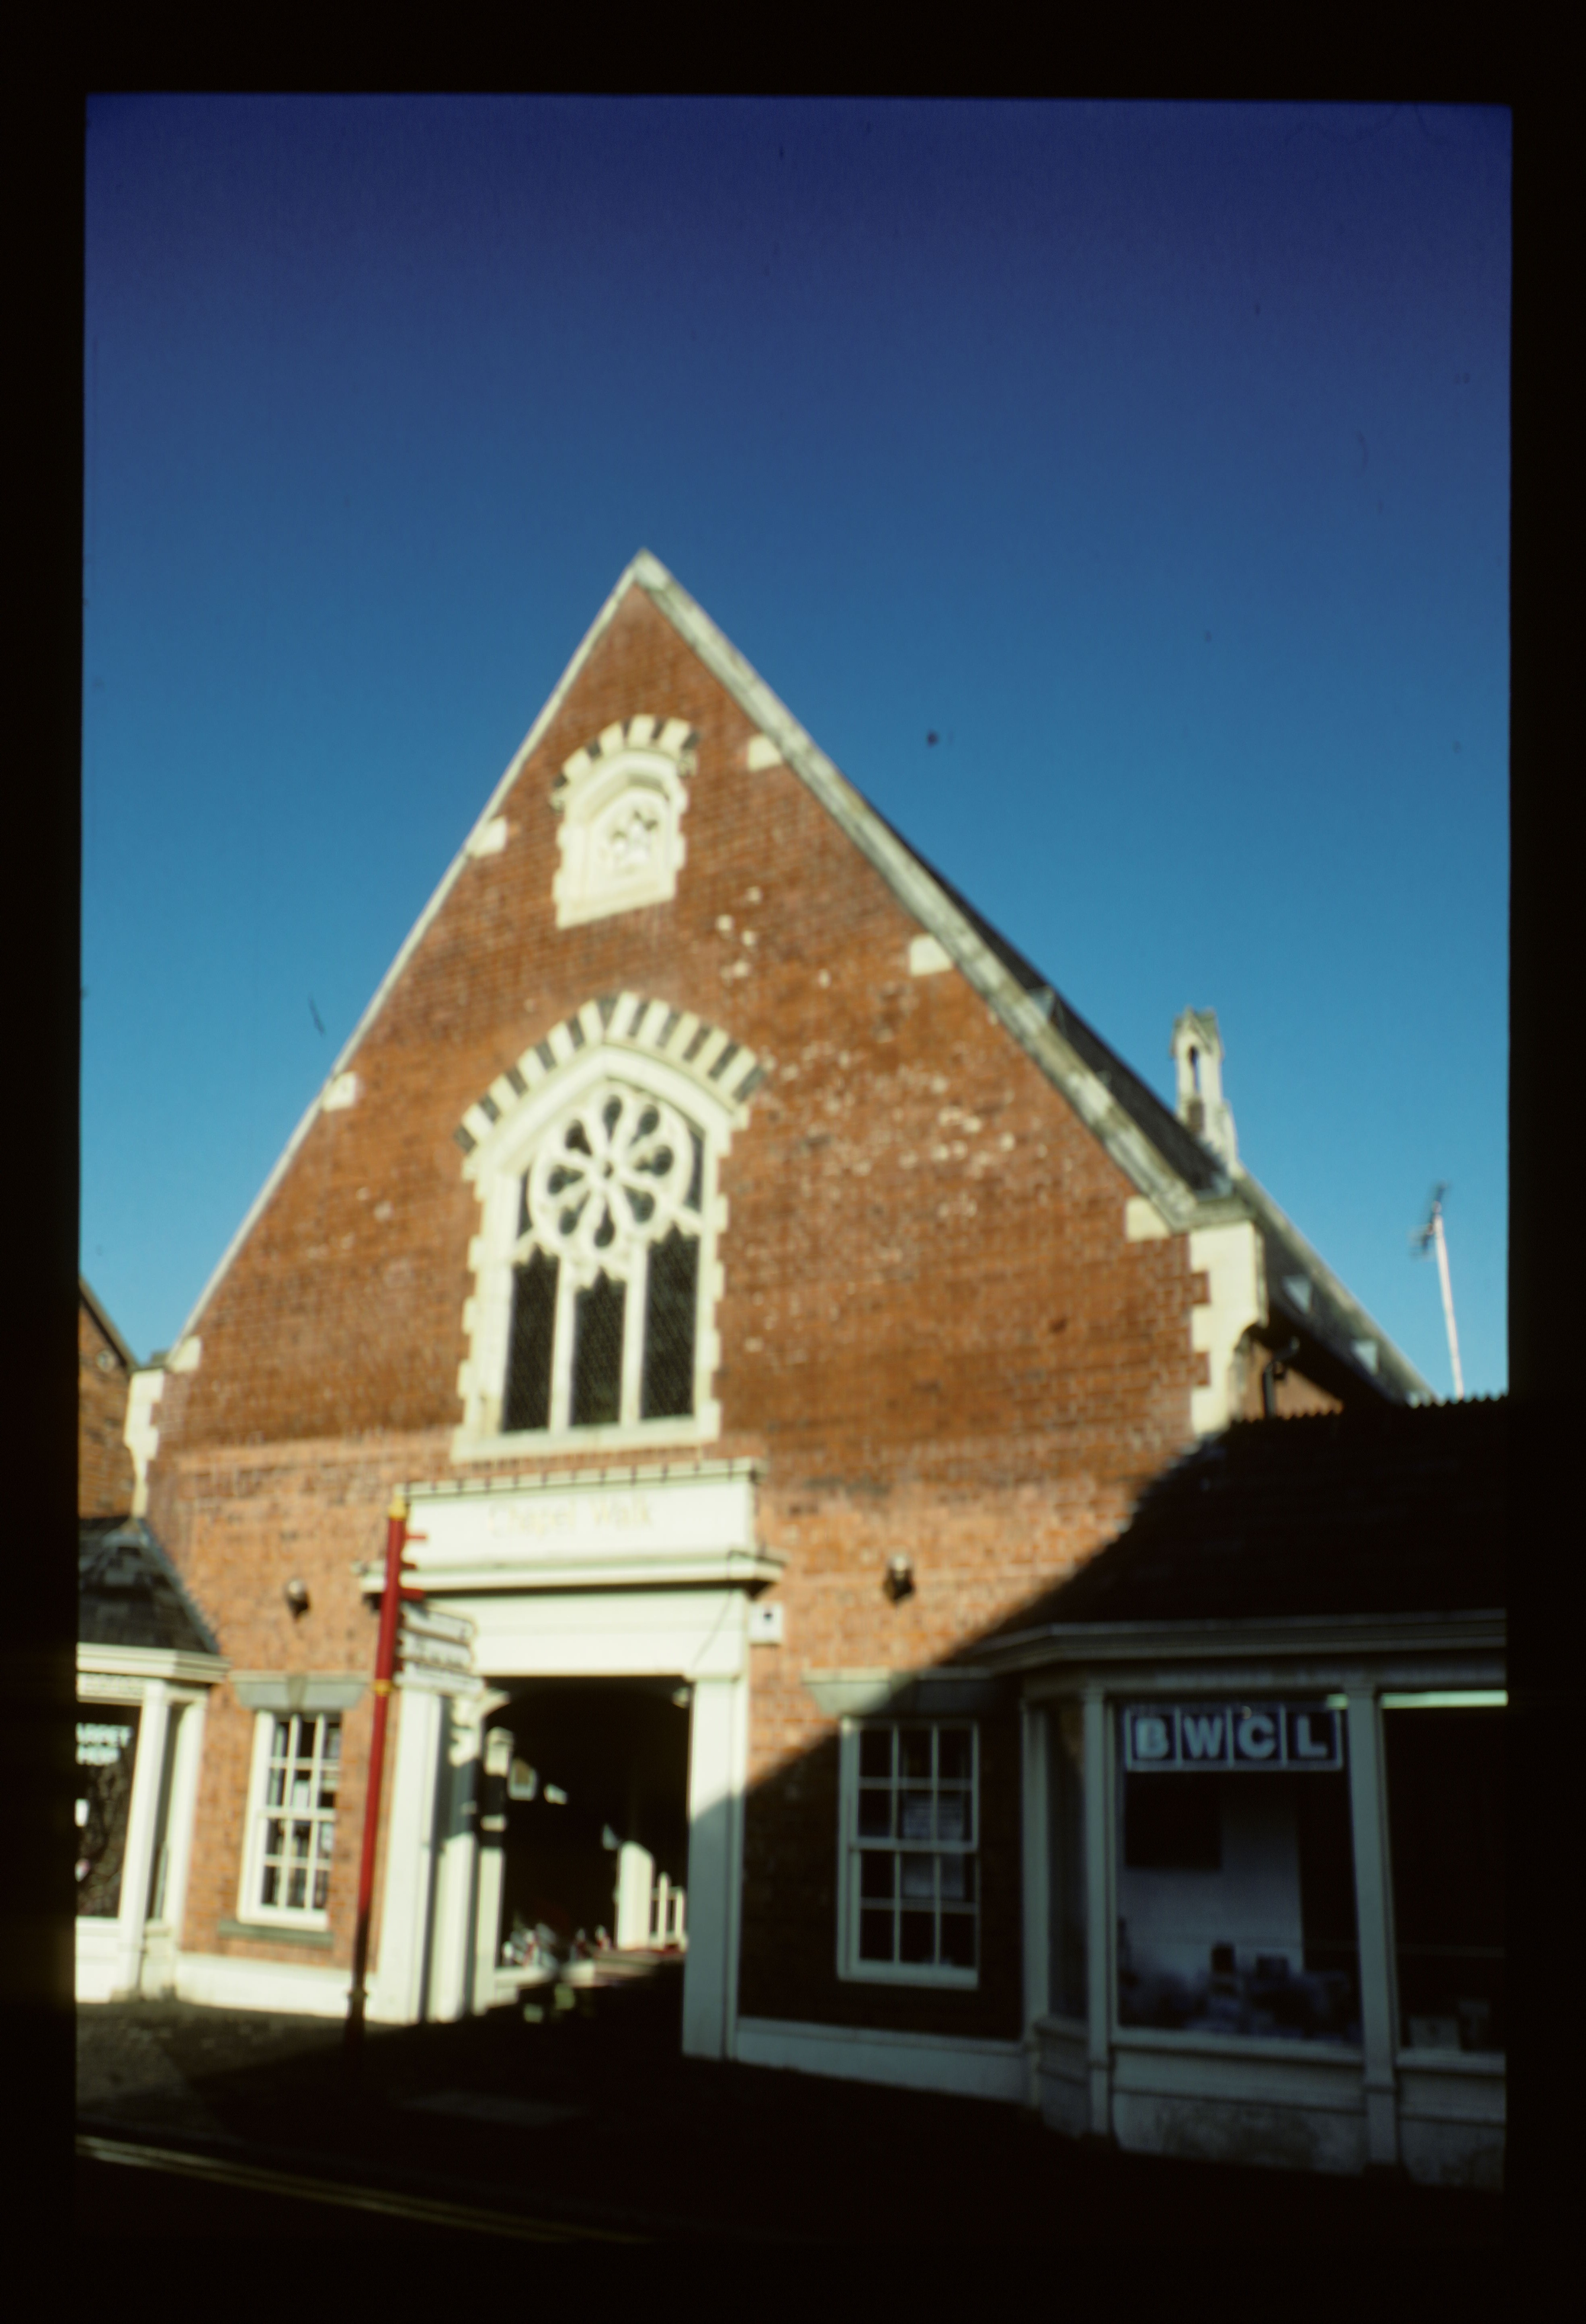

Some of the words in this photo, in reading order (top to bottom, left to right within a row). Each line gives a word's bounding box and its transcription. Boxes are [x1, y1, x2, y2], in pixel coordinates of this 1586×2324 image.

[488, 1496, 576, 1541] Chapel
[588, 1492, 654, 1531] Walk
[1135, 1714, 1328, 1759] BWCL
